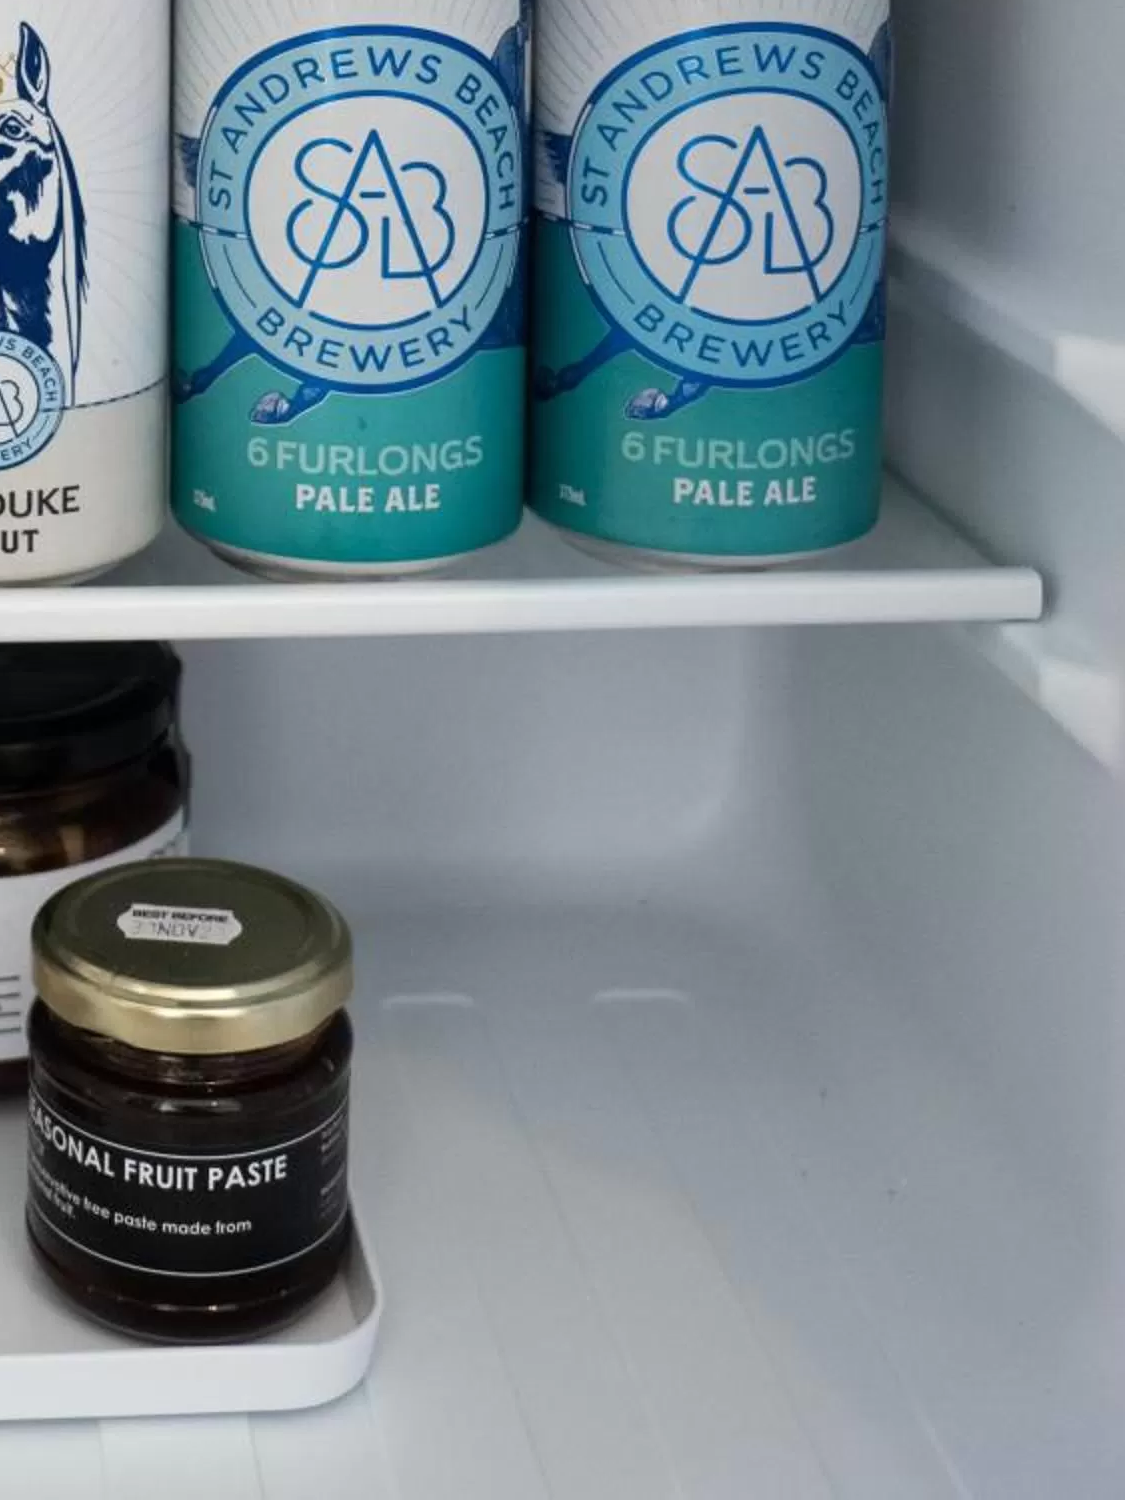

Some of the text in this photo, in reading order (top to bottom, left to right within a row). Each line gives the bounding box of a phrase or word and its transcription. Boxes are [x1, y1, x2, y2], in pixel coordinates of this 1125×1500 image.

[208, 46, 515, 211] ST ANDREWS BEACH
[581, 44, 884, 207] ST ANDREWS BEACH
[256, 304, 473, 373] BREWERY
[633, 300, 849, 368] BREWERY
[22, 345, 57, 402] BEACH
[247, 436, 484, 476] 6 FURLONGS
[621, 428, 856, 470] 6 FURLONGS
[295, 484, 442, 513] PALE ALE
[673, 476, 818, 507] PALE ALE
[124, 1157, 198, 1191] FRUIT
[207, 1155, 287, 1191] PASTE
[114, 1210, 157, 1232] paste
[162, 1220, 211, 1235] made
[215, 1219, 252, 1234] from
